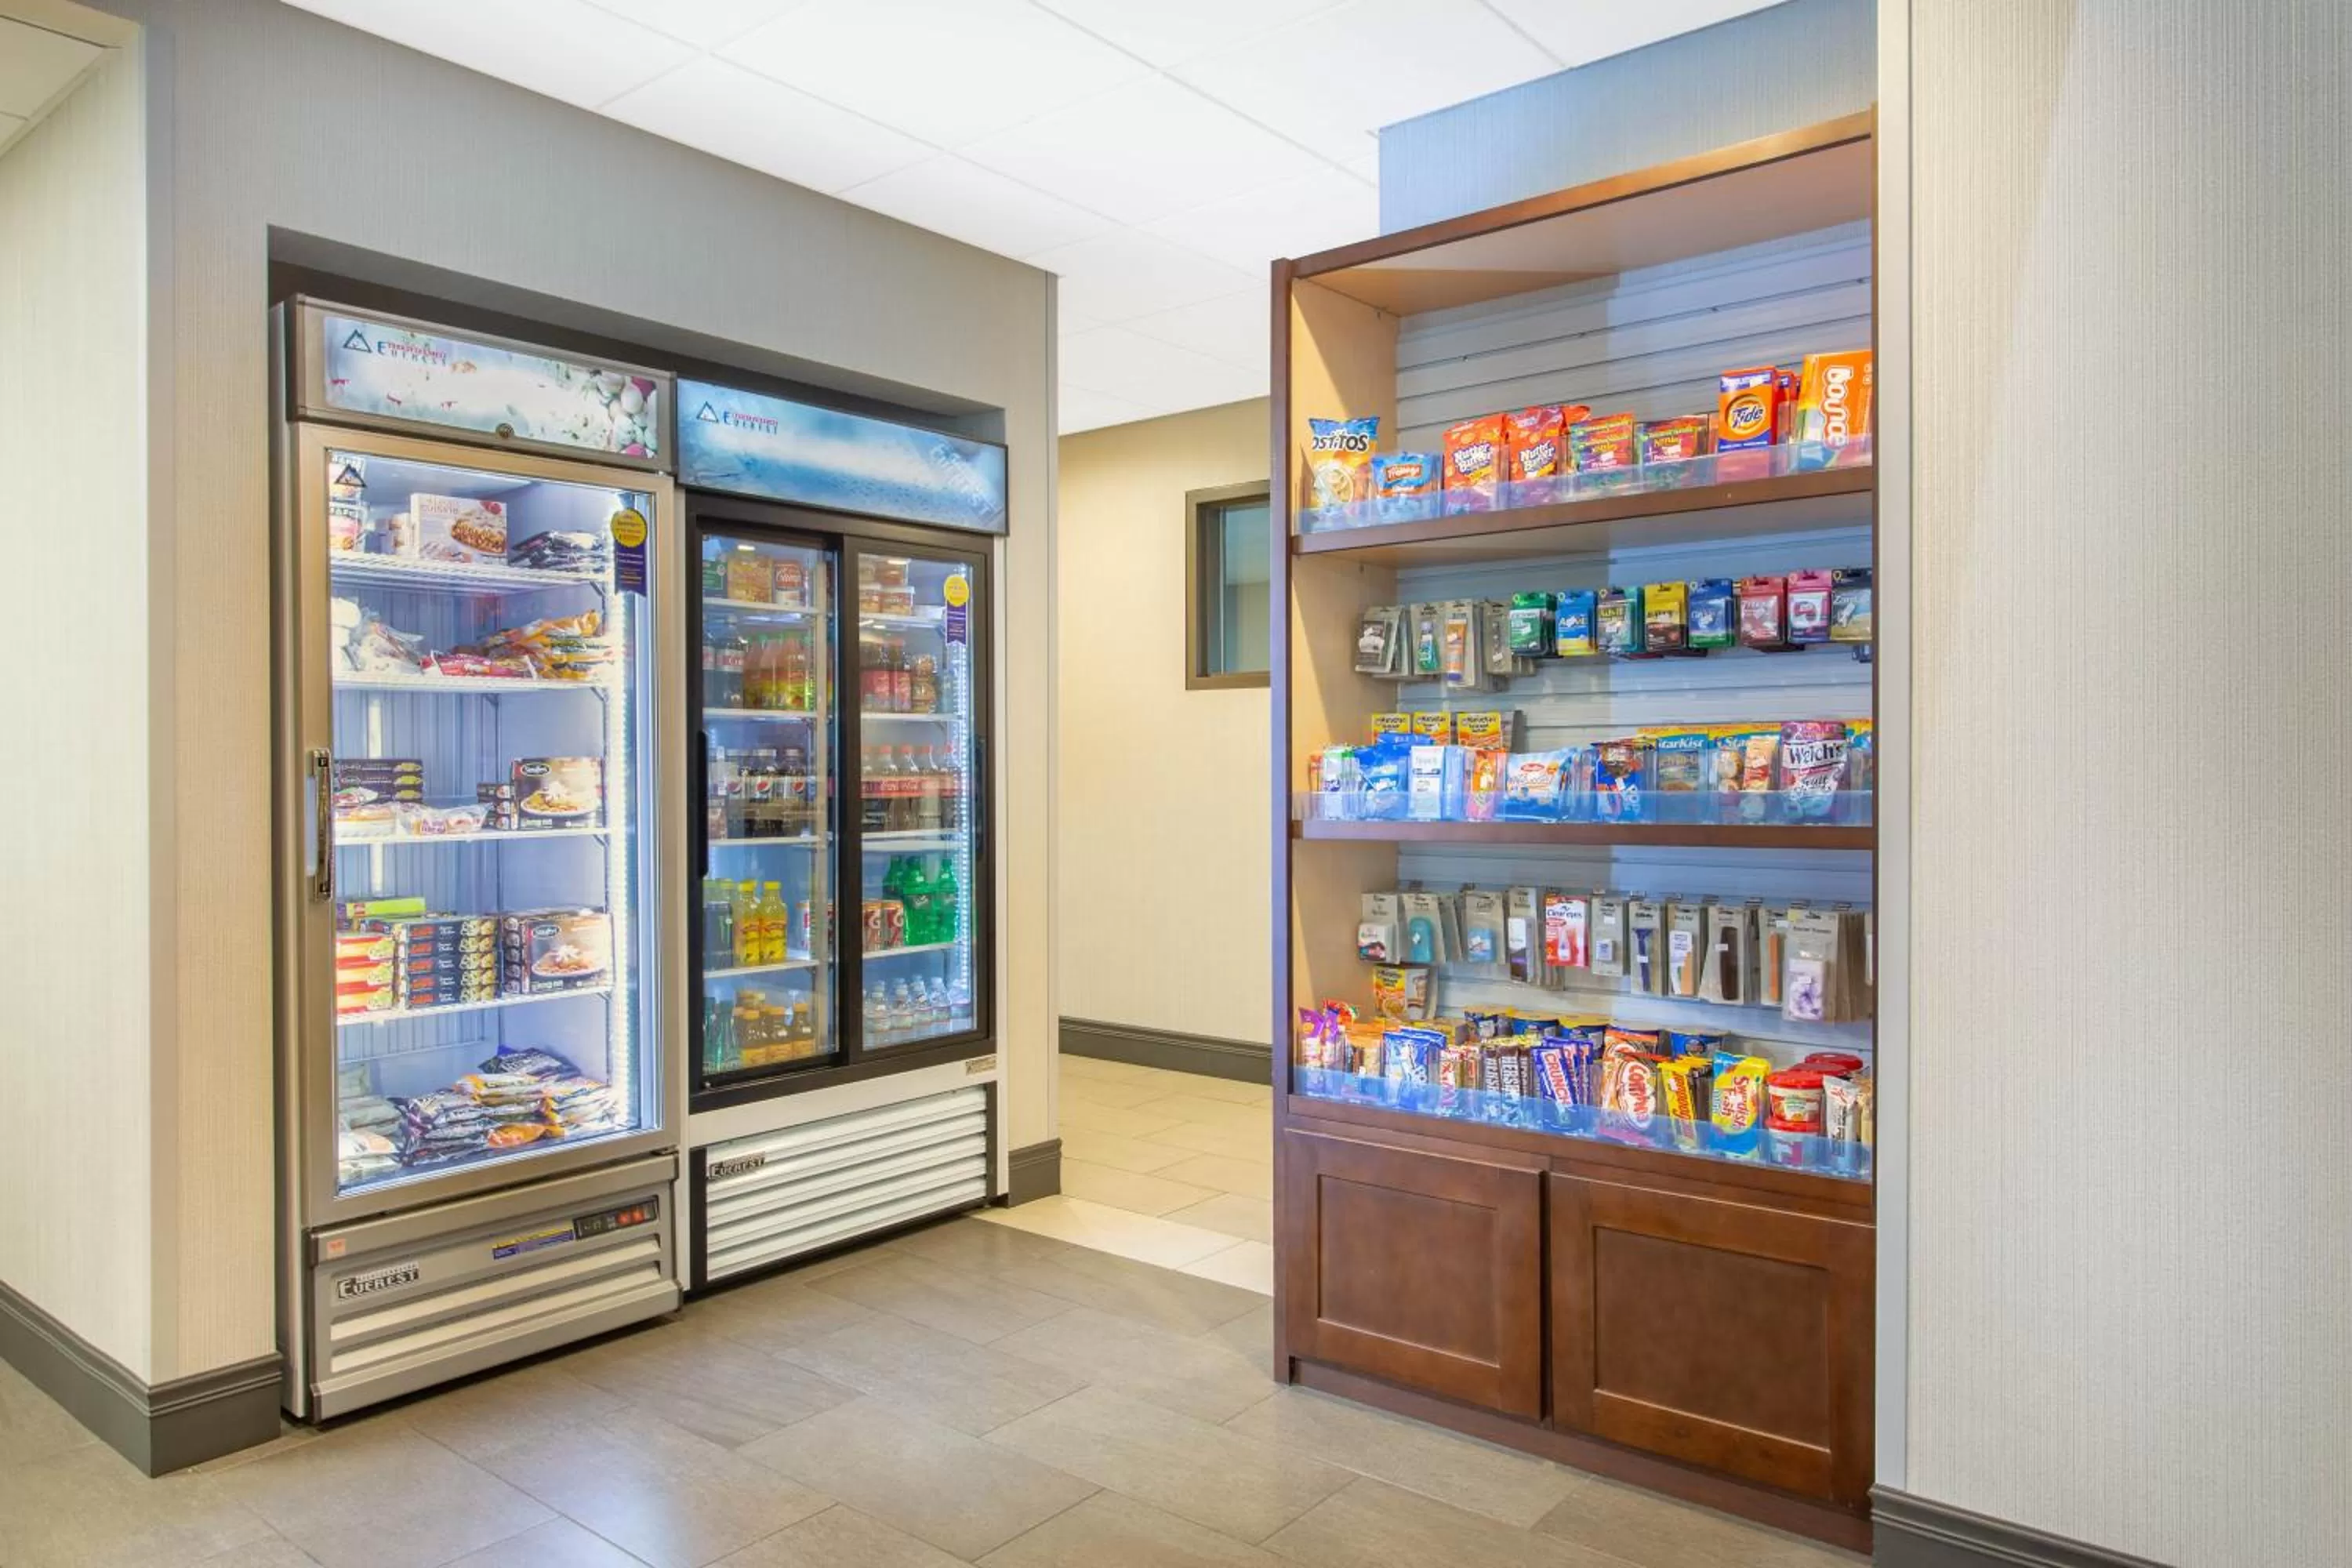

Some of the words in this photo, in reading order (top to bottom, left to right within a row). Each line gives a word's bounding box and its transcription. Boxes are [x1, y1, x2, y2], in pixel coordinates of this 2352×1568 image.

[1732, 405, 1764, 429] Tide
[1789, 742, 1843, 764] Welch's
[339, 1267, 419, 1298] EVEREST
